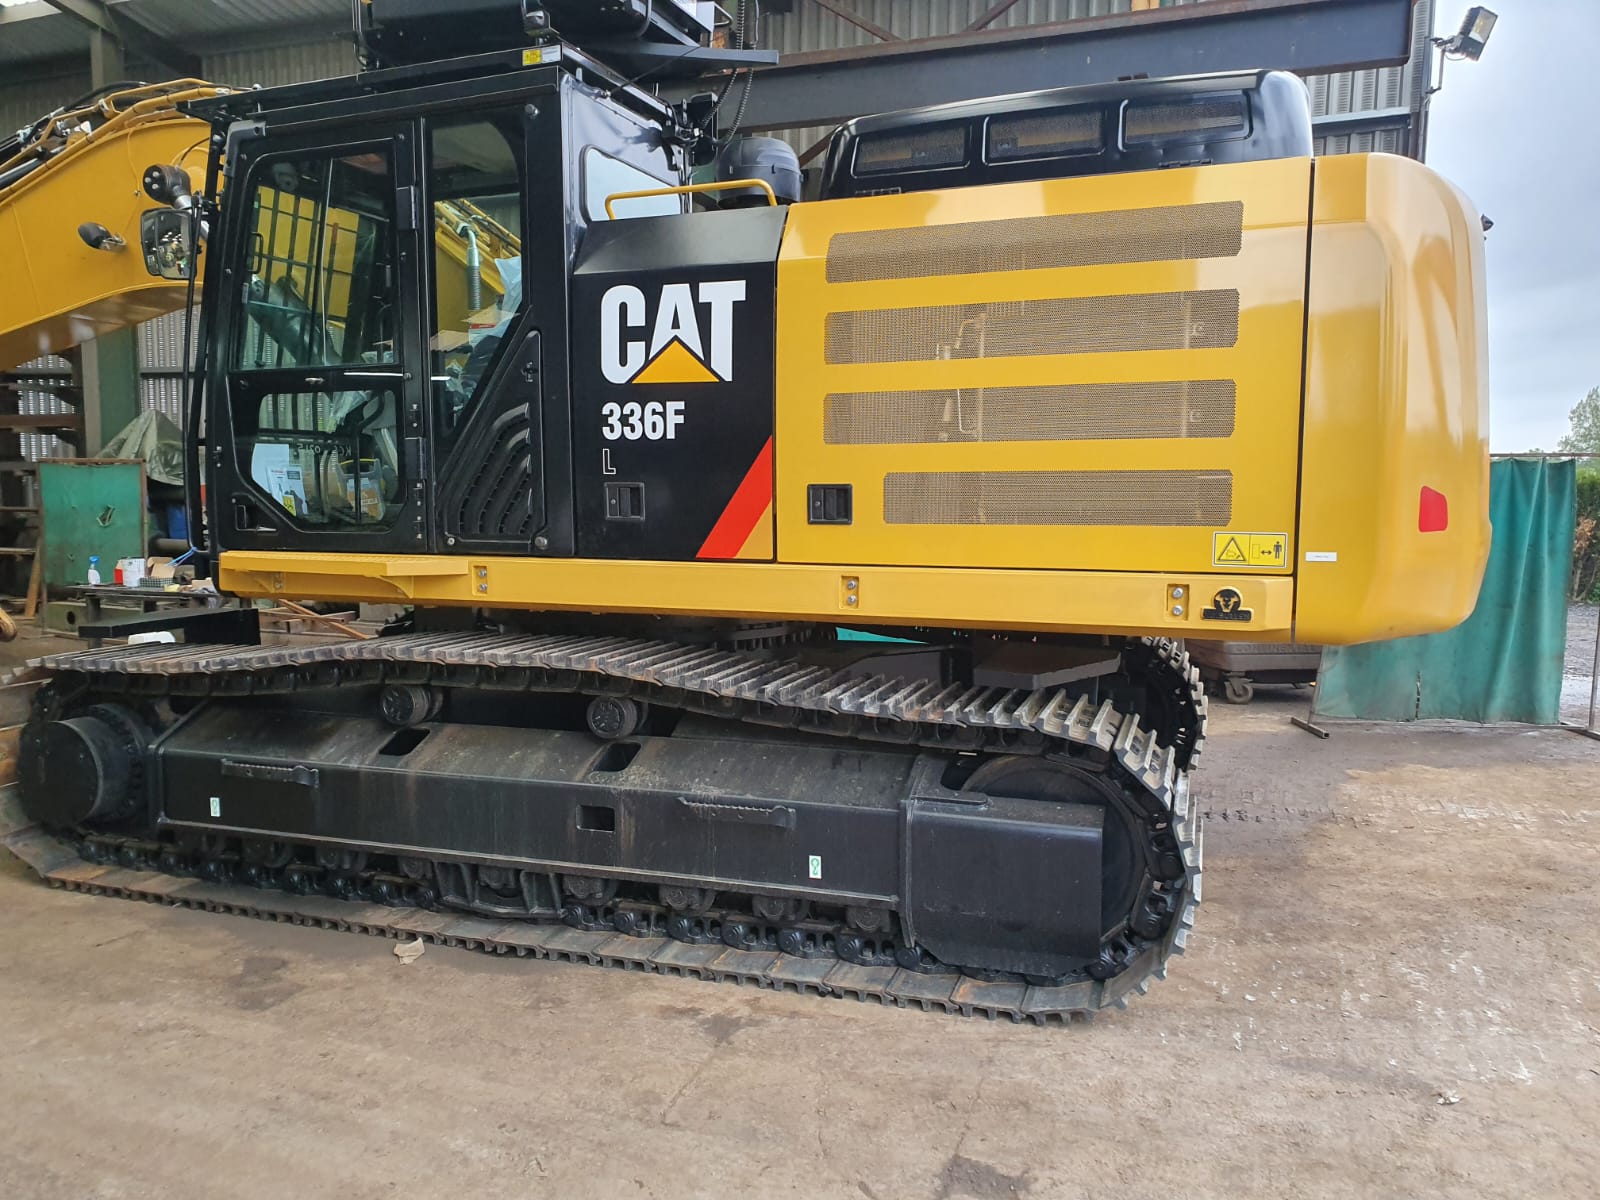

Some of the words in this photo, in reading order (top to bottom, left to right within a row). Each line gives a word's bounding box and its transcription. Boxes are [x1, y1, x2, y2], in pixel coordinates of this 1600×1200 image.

[600, 280, 746, 384] CAT
[602, 401, 685, 440] 336F
[602, 448, 616, 475] L
